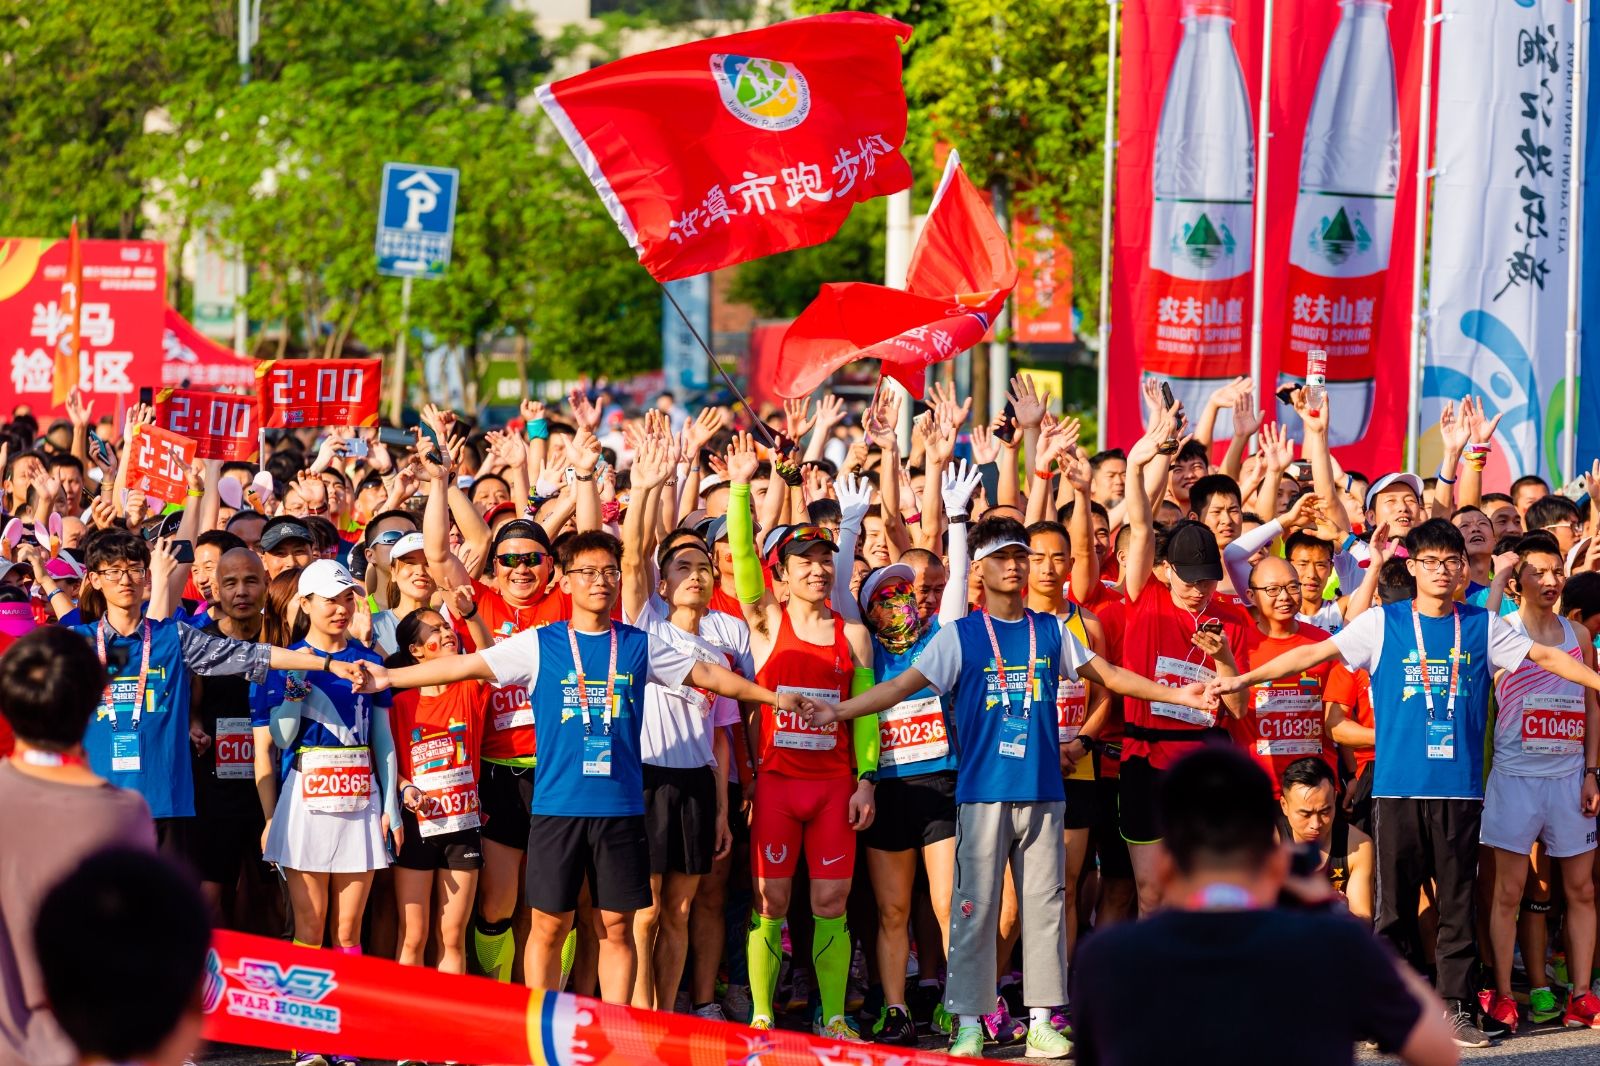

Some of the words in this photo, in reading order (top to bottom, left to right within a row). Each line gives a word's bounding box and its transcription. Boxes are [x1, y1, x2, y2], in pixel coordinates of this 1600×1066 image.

[726, 98, 758, 124] Xiangtan
[405, 188, 437, 232] P
[1157, 295, 1242, 326] 农夫山泉
[1292, 293, 1374, 326] 农夫山泉
[1156, 324, 1201, 342] NONGFU
[1204, 326, 1242, 342] SPRING
[1291, 323, 1329, 342] NONGFU
[1331, 327, 1371, 342] SPRING
[273, 369, 363, 404] 2:00
[169, 398, 250, 438] 2:00
[138, 432, 185, 481] 2:30
[1007, 673, 1028, 682] 202
[1427, 666, 1449, 675] 2021
[880, 719, 944, 749] C20236
[1259, 718, 1322, 737] C10395
[1525, 716, 1585, 738] C10466
[427, 737, 453, 751] 2021
[304, 773, 369, 796] C20365
[231, 992, 270, 1011] WAR
[274, 1000, 337, 1022] HORSE
